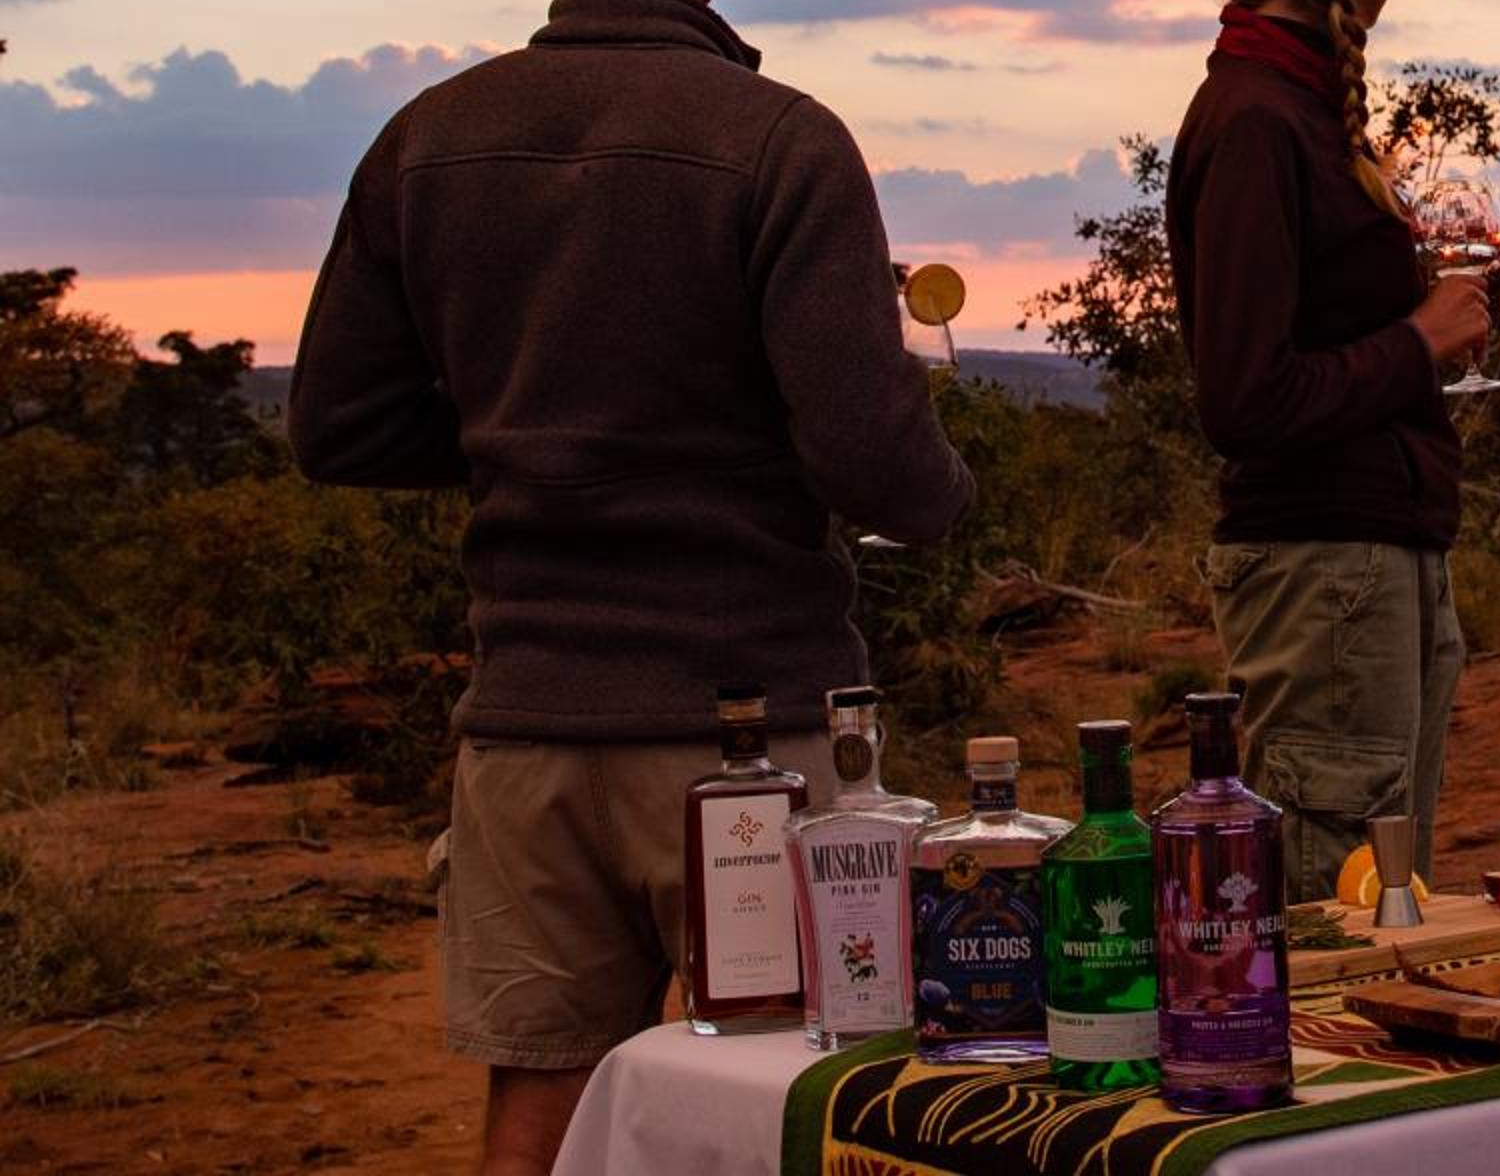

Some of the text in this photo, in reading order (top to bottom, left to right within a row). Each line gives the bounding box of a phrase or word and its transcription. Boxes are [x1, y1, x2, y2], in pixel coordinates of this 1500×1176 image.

[811, 840, 898, 883] MUSGRAVE
[737, 893, 762, 905] GIN
[831, 883, 881, 896] PINK GIN
[1178, 919, 1250, 939] WHITLEY
[948, 936, 1032, 961] SIX DOGS
[1062, 939, 1125, 958] WHITLEY
[970, 983, 1011, 1000] BLUE
